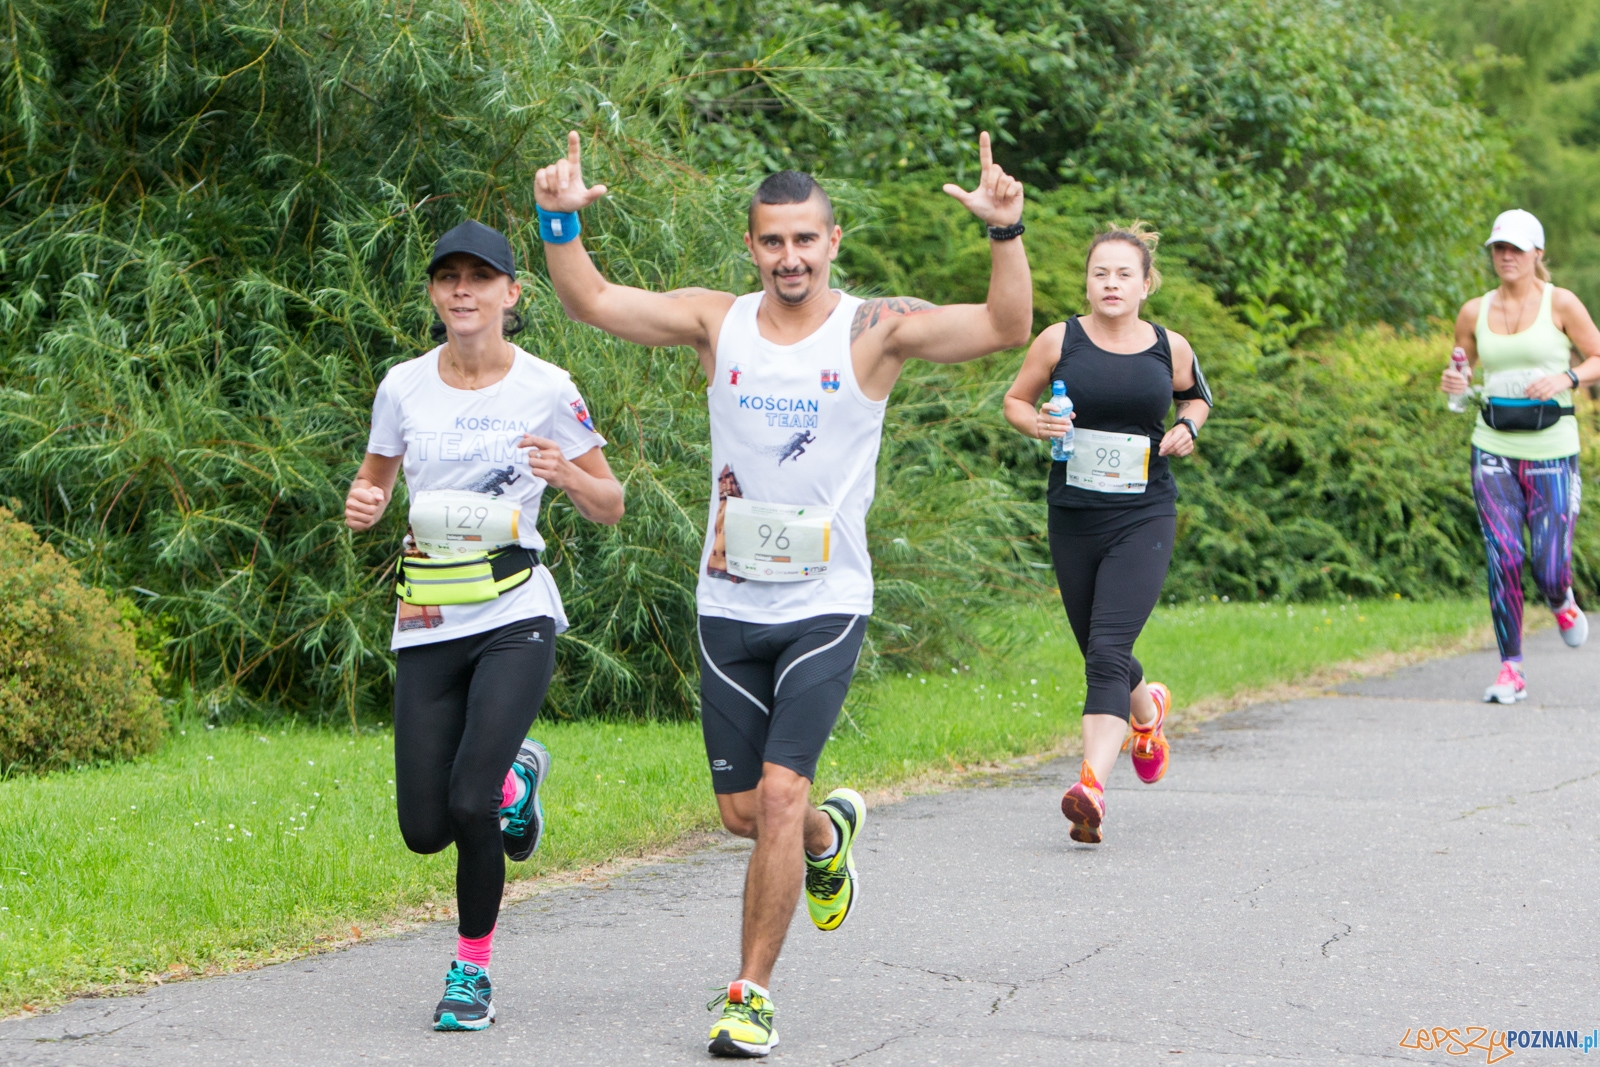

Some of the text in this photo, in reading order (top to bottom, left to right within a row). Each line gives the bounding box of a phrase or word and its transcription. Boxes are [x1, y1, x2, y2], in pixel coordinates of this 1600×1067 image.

[1505, 381, 1528, 398] 10
[740, 395, 818, 412] KOŚCIAN
[455, 416, 529, 432] KOŚCIAN
[766, 413, 818, 428] TEAM
[415, 431, 527, 465] TEAM
[1095, 447, 1121, 468] 98
[444, 505, 489, 529] 129
[758, 524, 790, 550] 96
